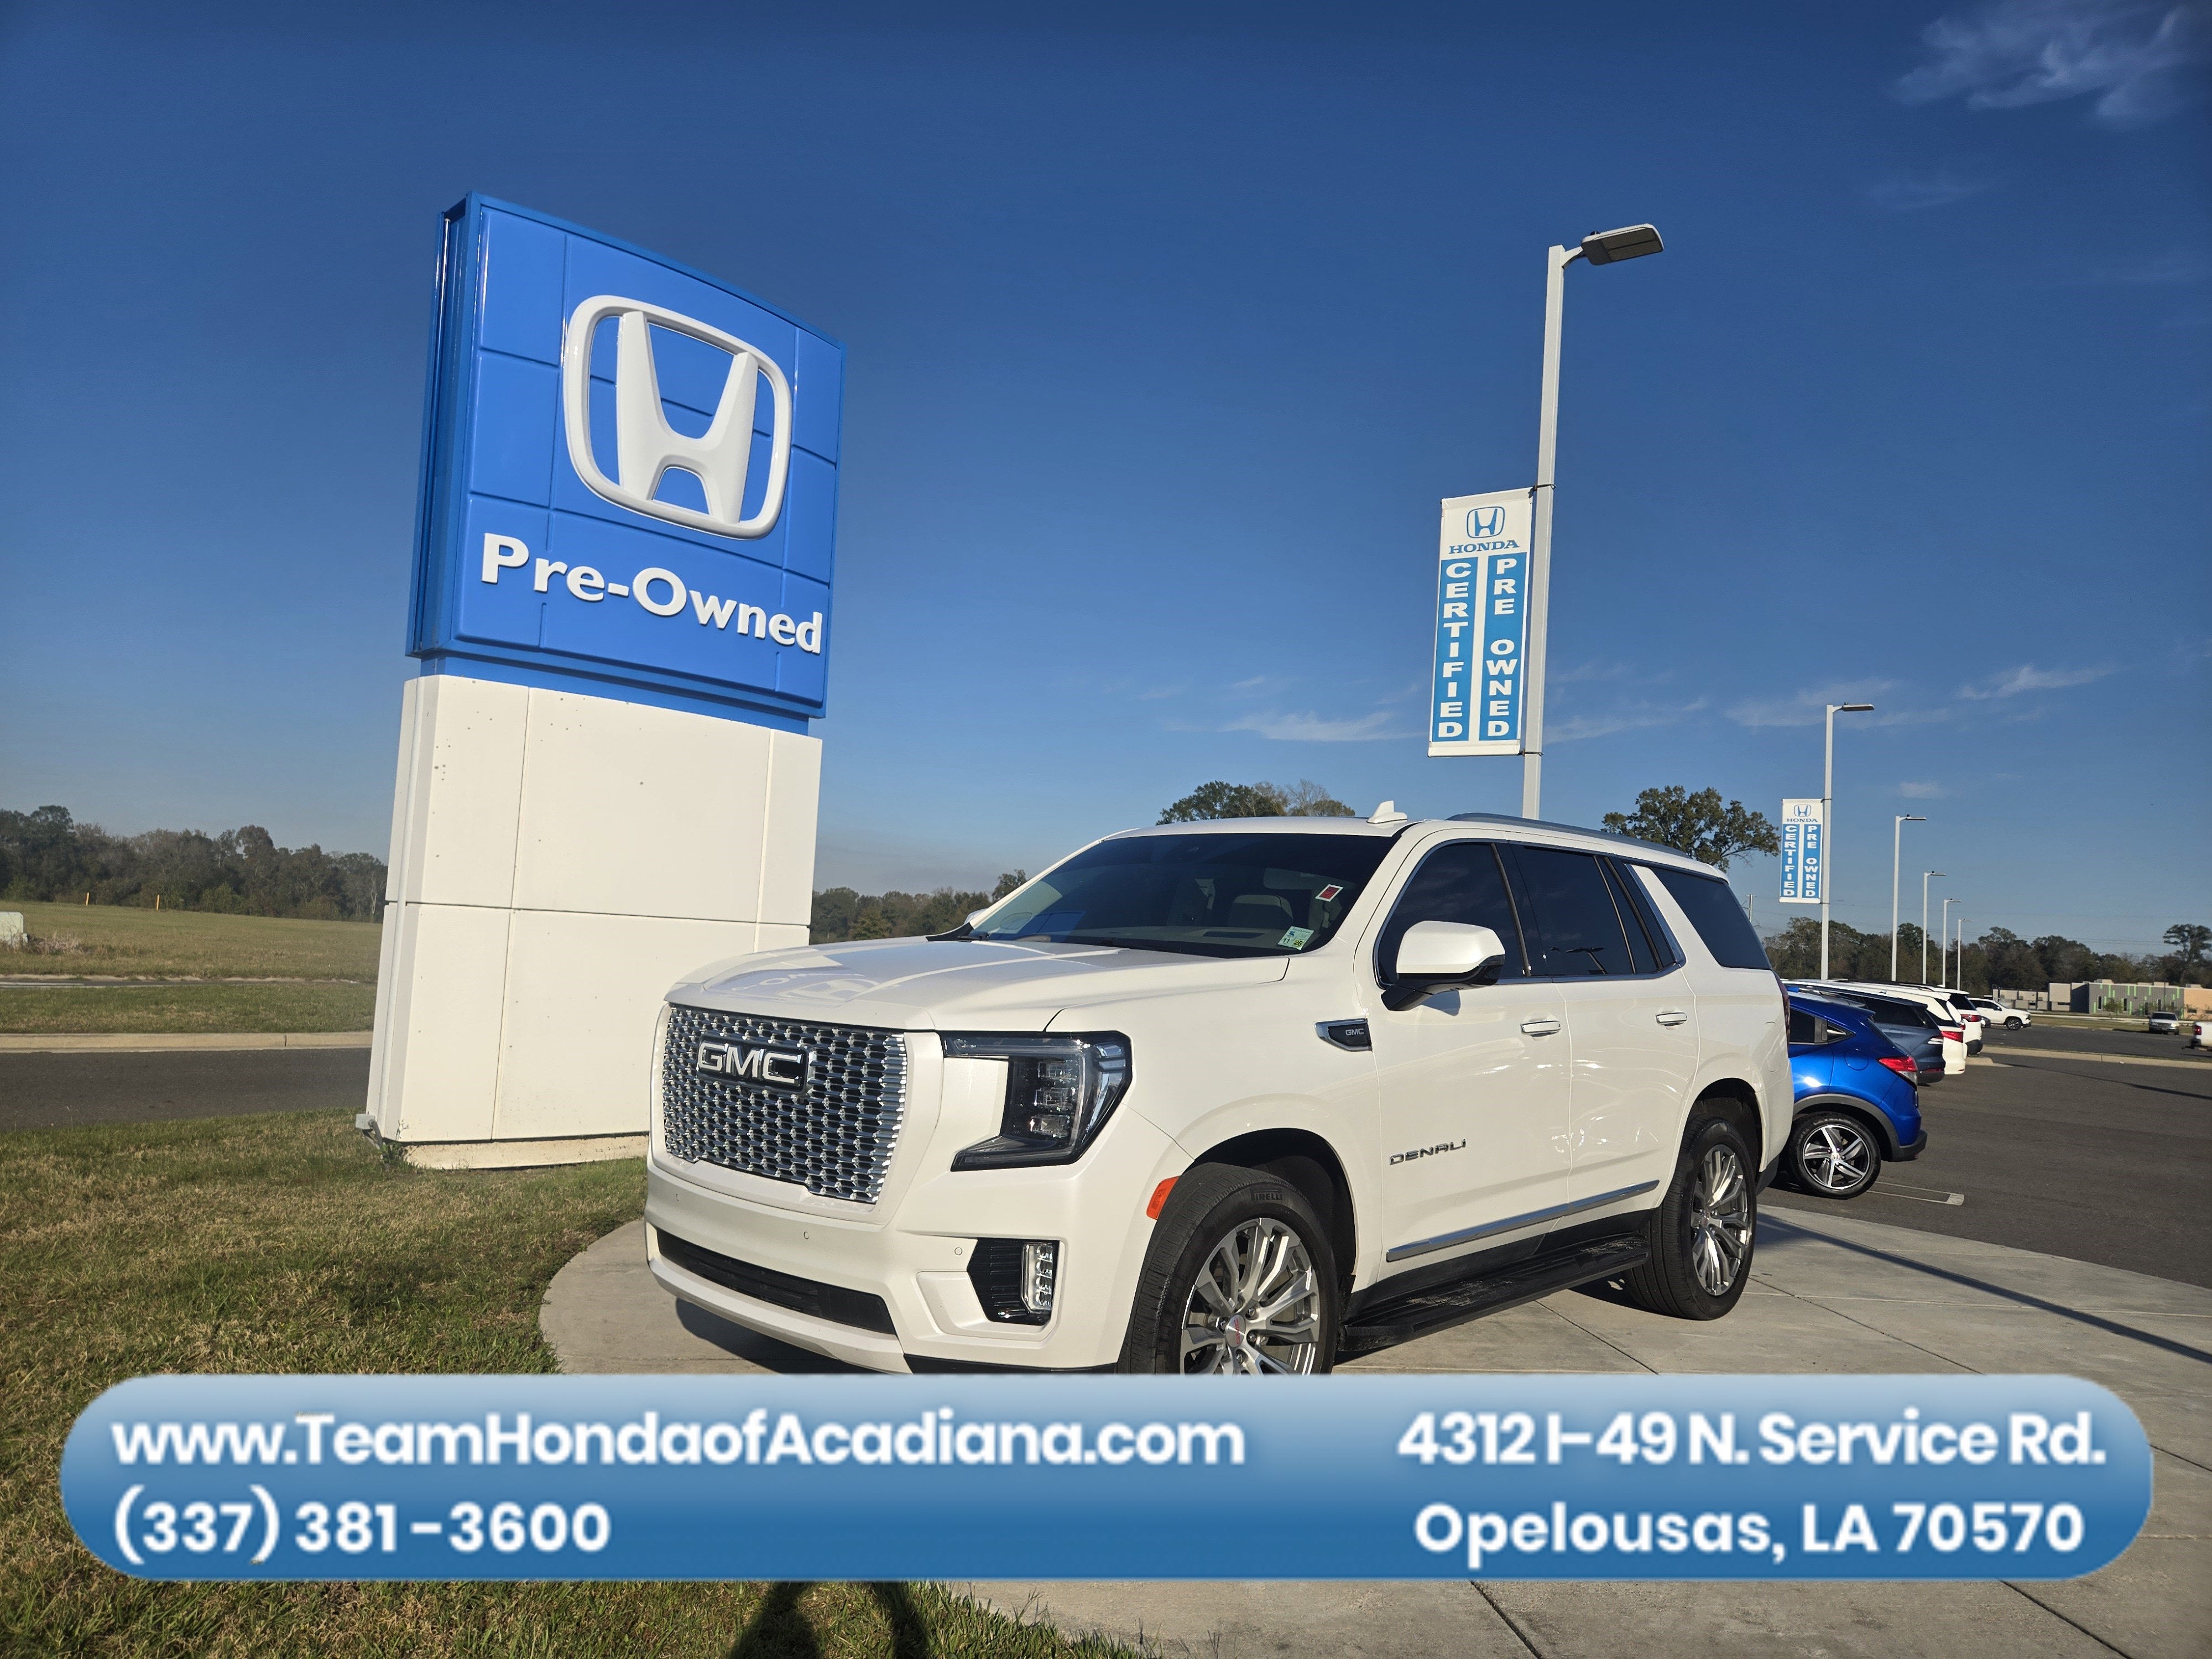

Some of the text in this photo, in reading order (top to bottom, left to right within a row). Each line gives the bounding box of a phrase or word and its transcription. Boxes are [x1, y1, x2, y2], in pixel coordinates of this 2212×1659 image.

[1448, 540, 1520, 554] HONDA
[481, 532, 822, 655] Pre-Owned
[1438, 562, 1472, 738] CERTIFIED
[1486, 558, 1518, 737] PRE OWNED
[1783, 825, 1797, 896] CERTIFIED
[1804, 825, 1819, 897] PRE OWNED
[697, 1042, 802, 1086] GMC
[1389, 1139, 1466, 1166] DENALI
[1249, 1188, 1284, 1201] PIRELLI
